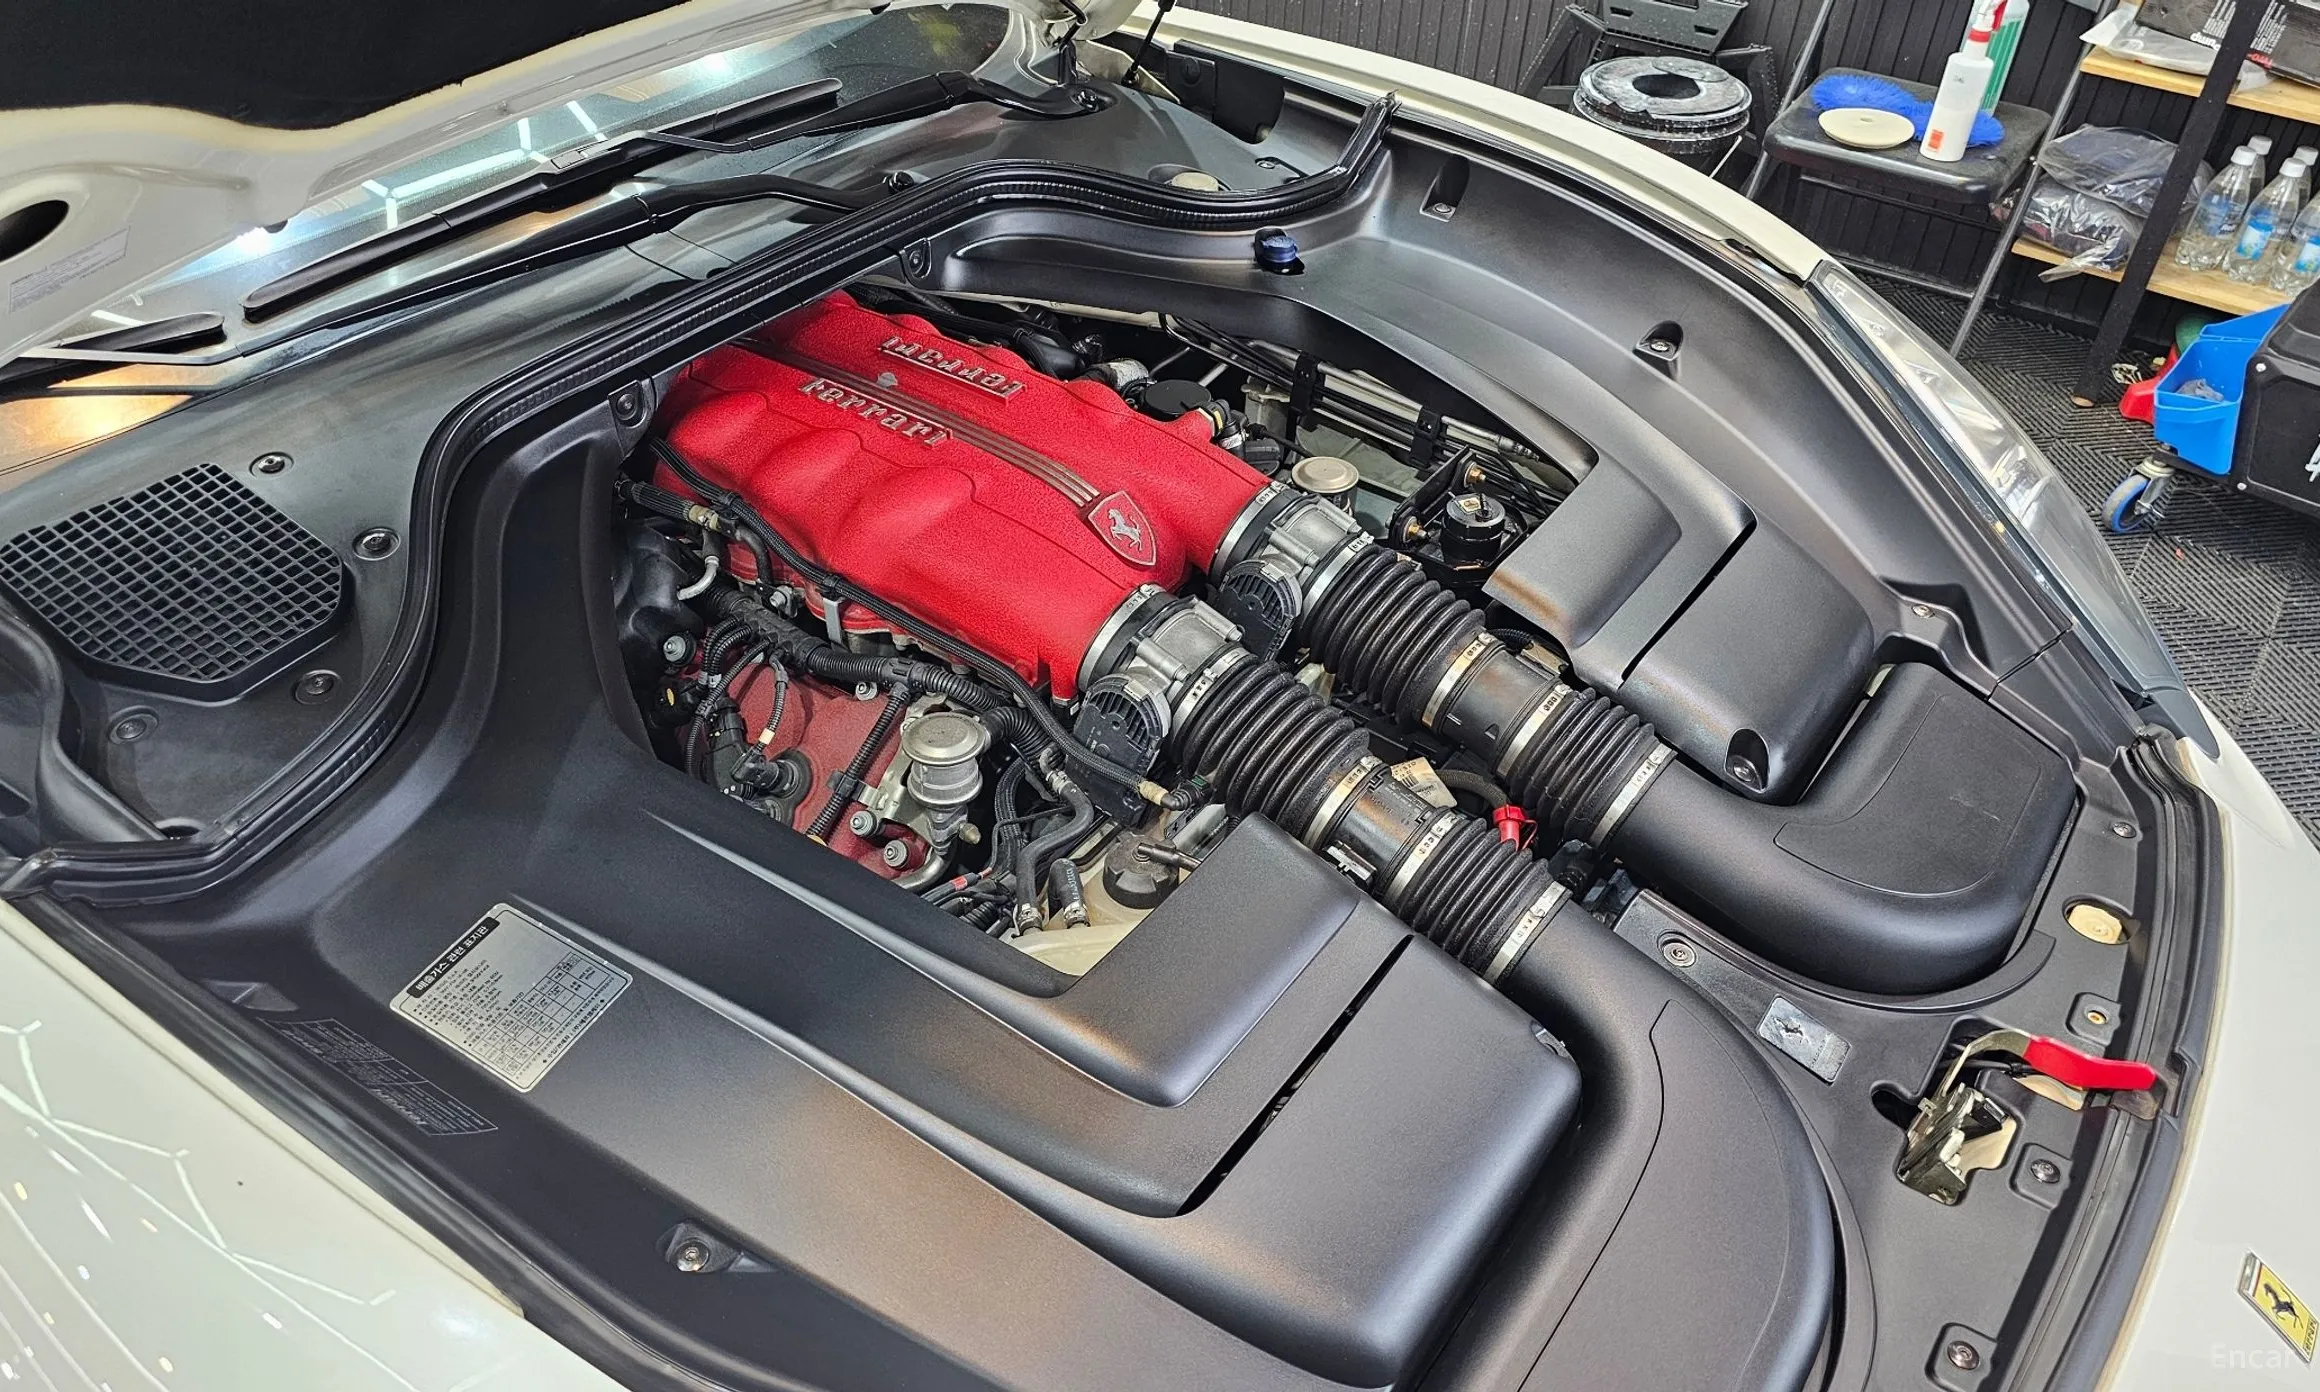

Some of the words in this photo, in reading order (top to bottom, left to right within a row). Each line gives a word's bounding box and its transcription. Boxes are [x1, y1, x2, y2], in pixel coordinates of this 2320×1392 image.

[880, 335, 1027, 406] Ferrari
[800, 377, 953, 448] Ferrari
[414, 960, 450, 992] 배출가스
[445, 945, 467, 962] 관련
[461, 925, 489, 948] 표지판
